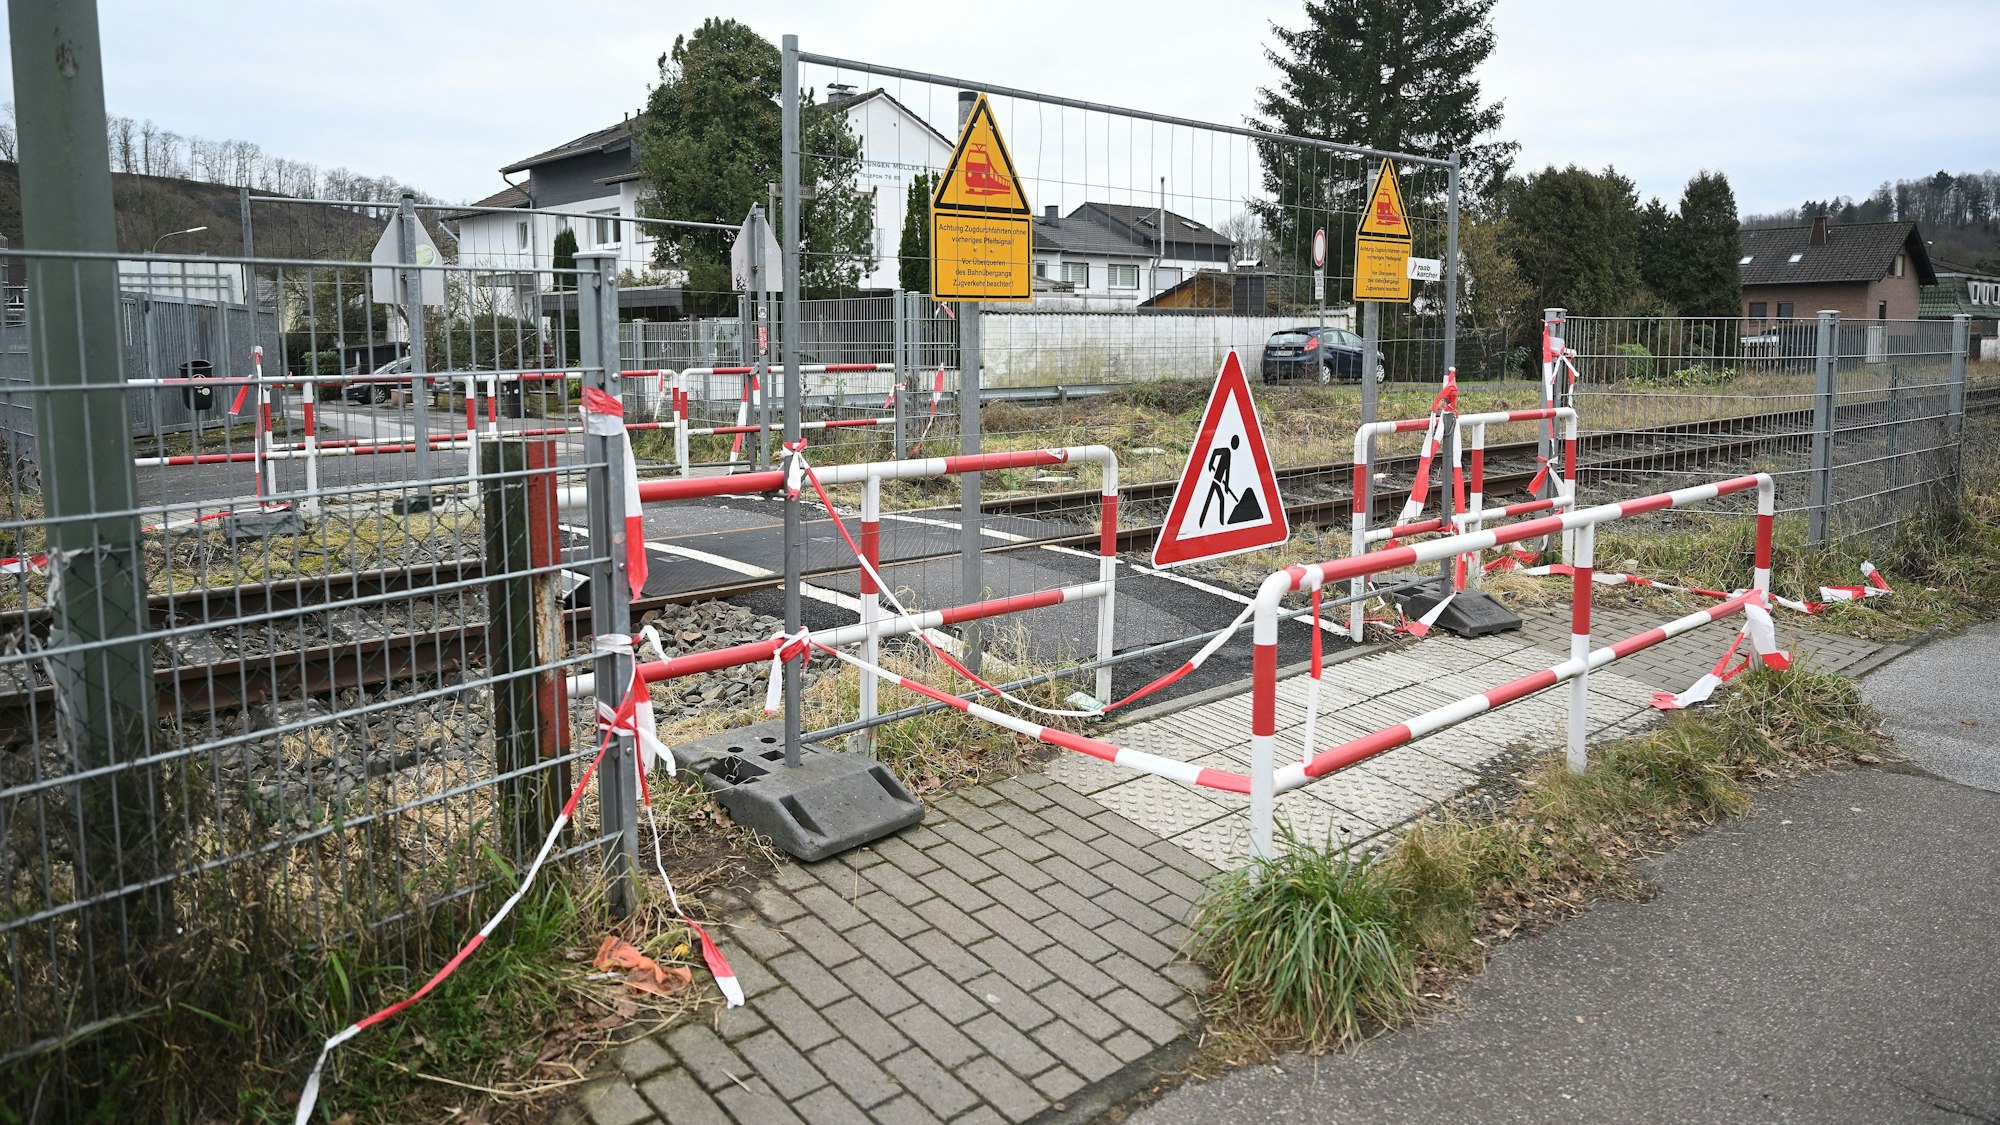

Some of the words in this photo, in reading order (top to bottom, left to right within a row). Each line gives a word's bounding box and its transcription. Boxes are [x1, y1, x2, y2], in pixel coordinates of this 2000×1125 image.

[938, 223, 964, 233] Achtung
[964, 225, 1011, 235] Zugdurchfahrten
[1012, 228, 1027, 236] ohne
[952, 237, 982, 245] vorheriges
[972, 257, 1005, 267] Überqueren
[955, 268, 965, 276] des
[967, 269, 1012, 278] Bahnübergangs
[1416, 271, 1438, 279] karcher
[952, 279, 986, 288] Zugverkehr
